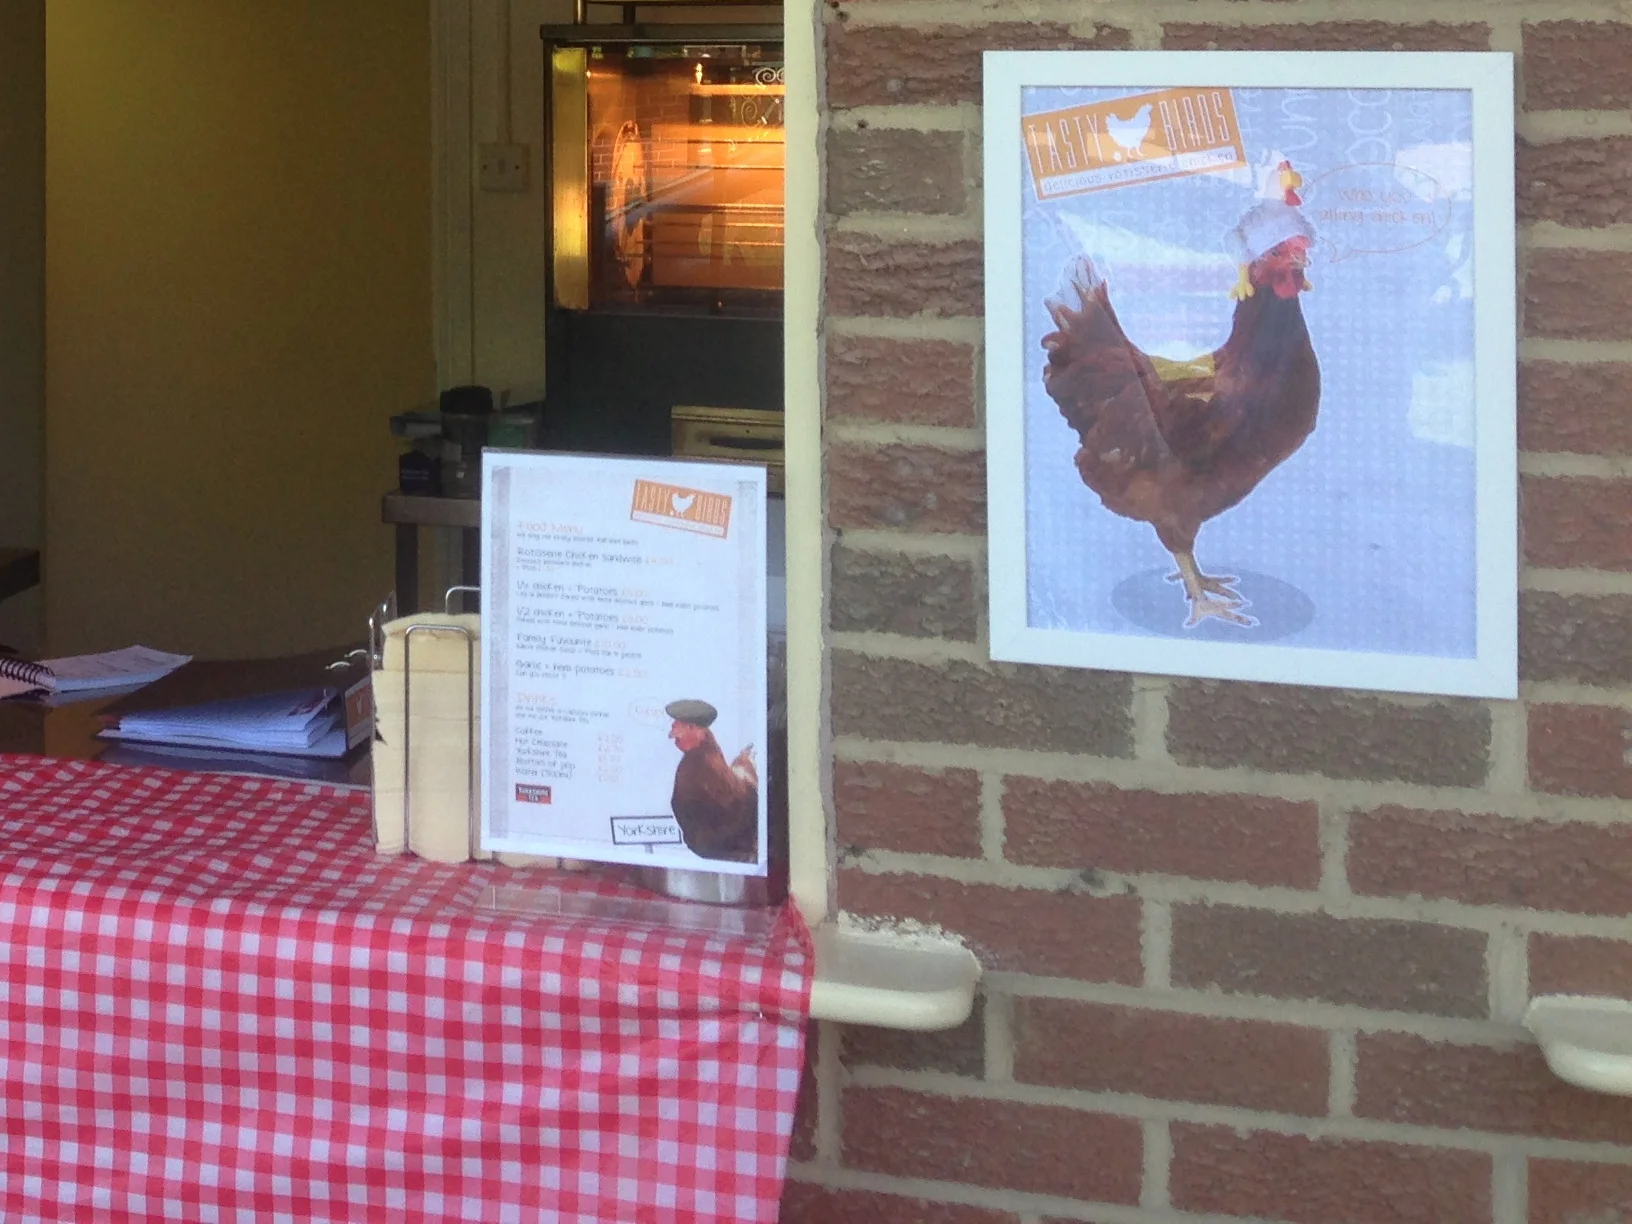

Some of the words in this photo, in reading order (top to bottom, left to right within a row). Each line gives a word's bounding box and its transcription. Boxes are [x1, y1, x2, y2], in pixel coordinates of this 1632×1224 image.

[1028, 113, 1104, 174] TASTY
[1159, 92, 1230, 150] BIRDS
[635, 482, 669, 513] TASTY
